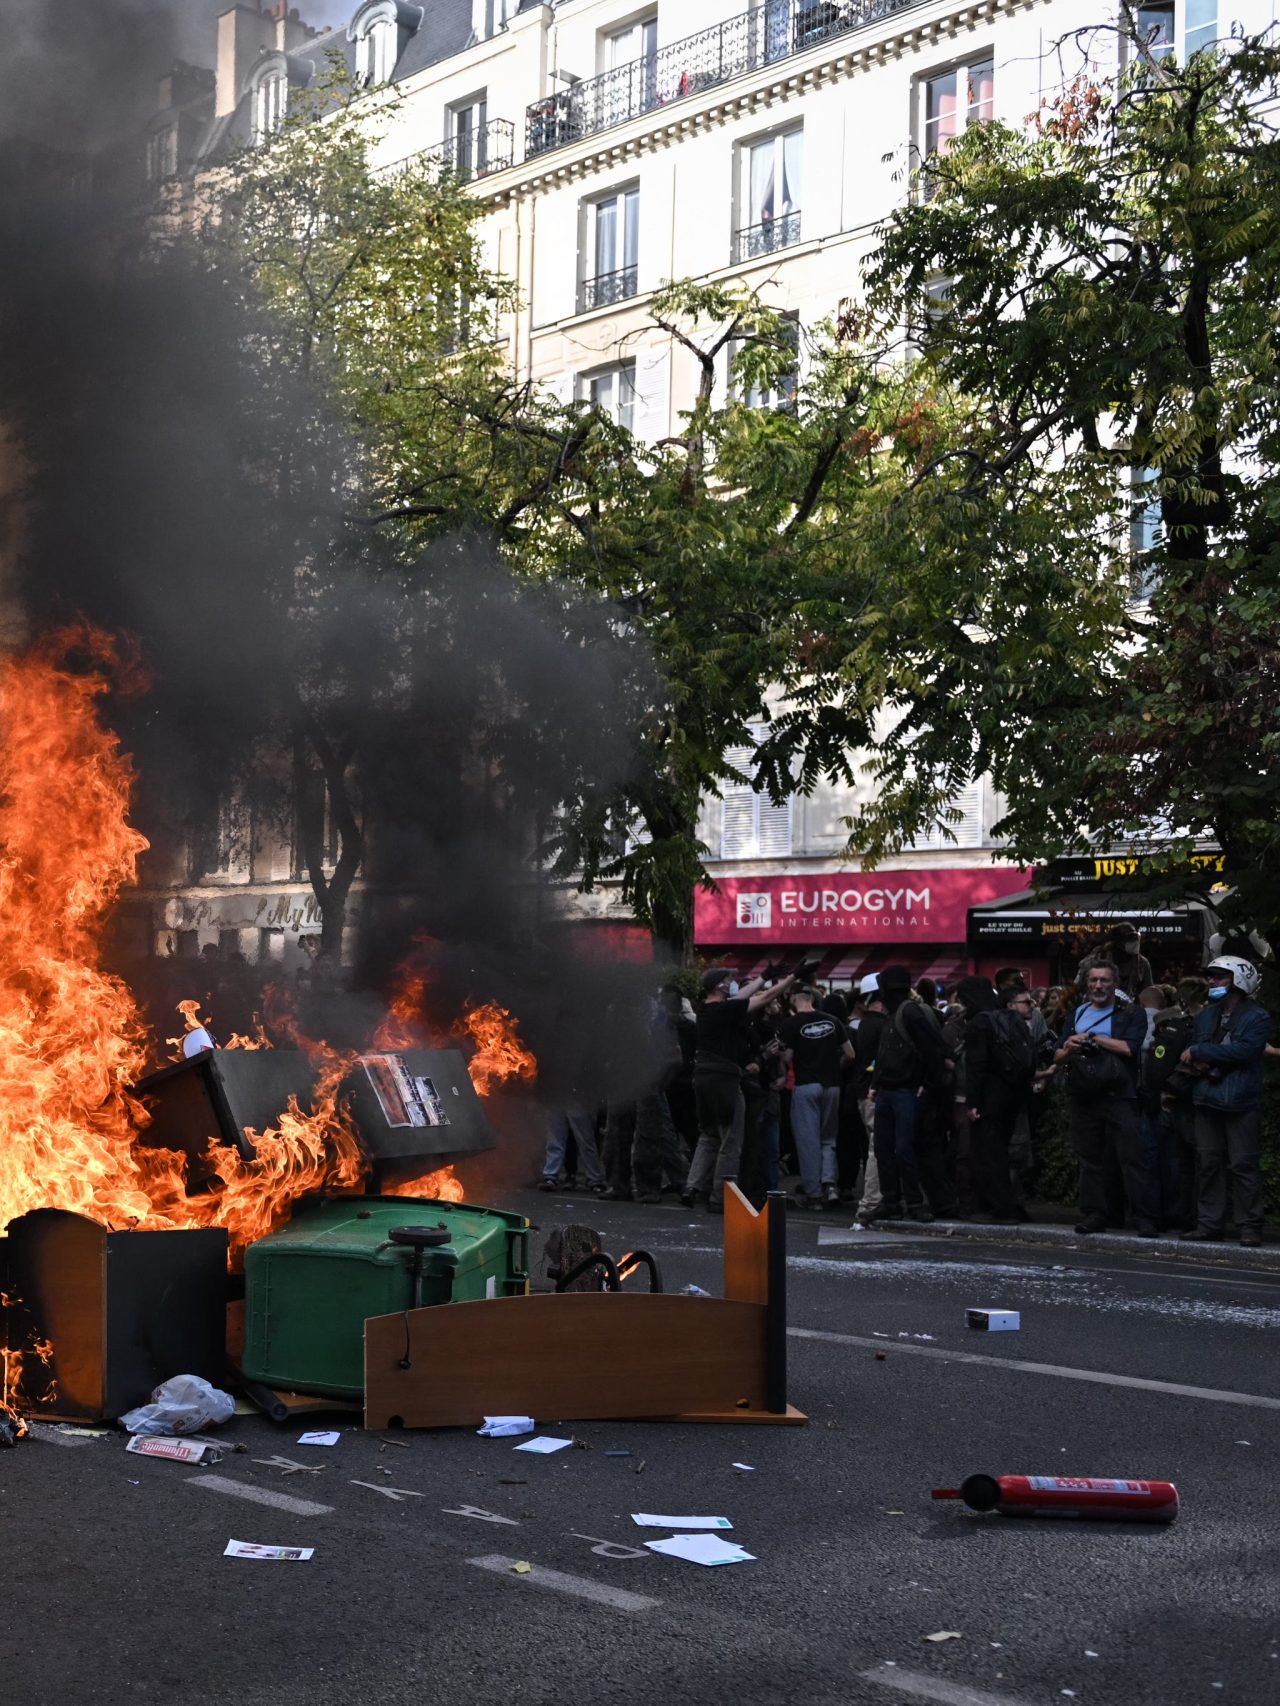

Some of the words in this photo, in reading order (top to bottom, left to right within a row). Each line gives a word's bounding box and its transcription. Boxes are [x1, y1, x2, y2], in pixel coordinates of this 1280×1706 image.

[1093, 858, 1140, 881] JUST
[781, 888, 930, 912] EUROGYM
[781, 916, 930, 927] INTERNATIONAL
[1040, 922, 1066, 936] just
[141, 1442, 190, 1459] l'Humanité
